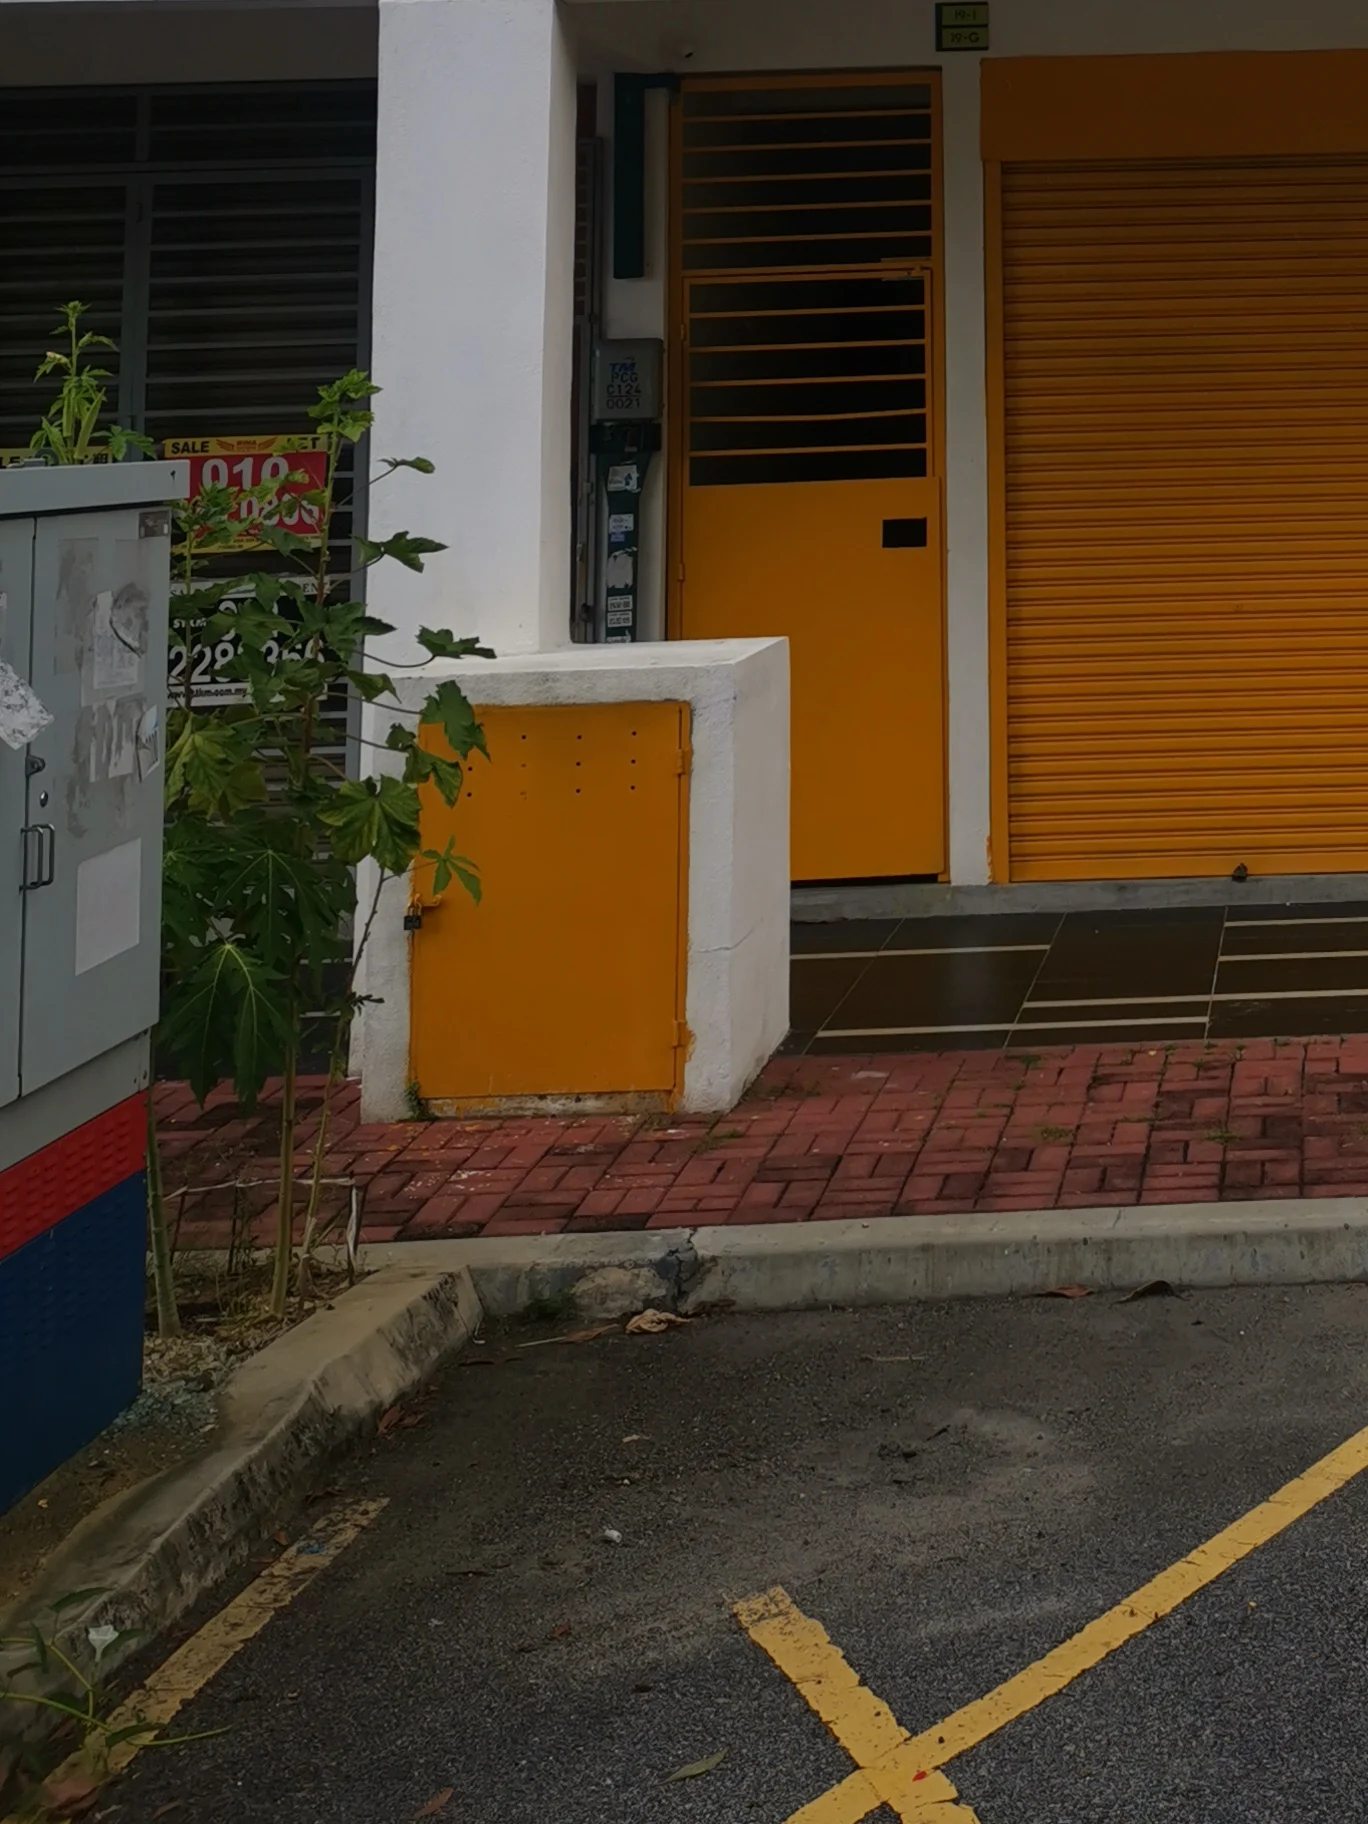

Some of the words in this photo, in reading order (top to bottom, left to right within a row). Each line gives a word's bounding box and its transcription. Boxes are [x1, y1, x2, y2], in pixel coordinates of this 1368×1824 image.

[950, 31, 980, 44] 19-G
[606, 397, 640, 410] 0021
[171, 440, 210, 455] SALE
